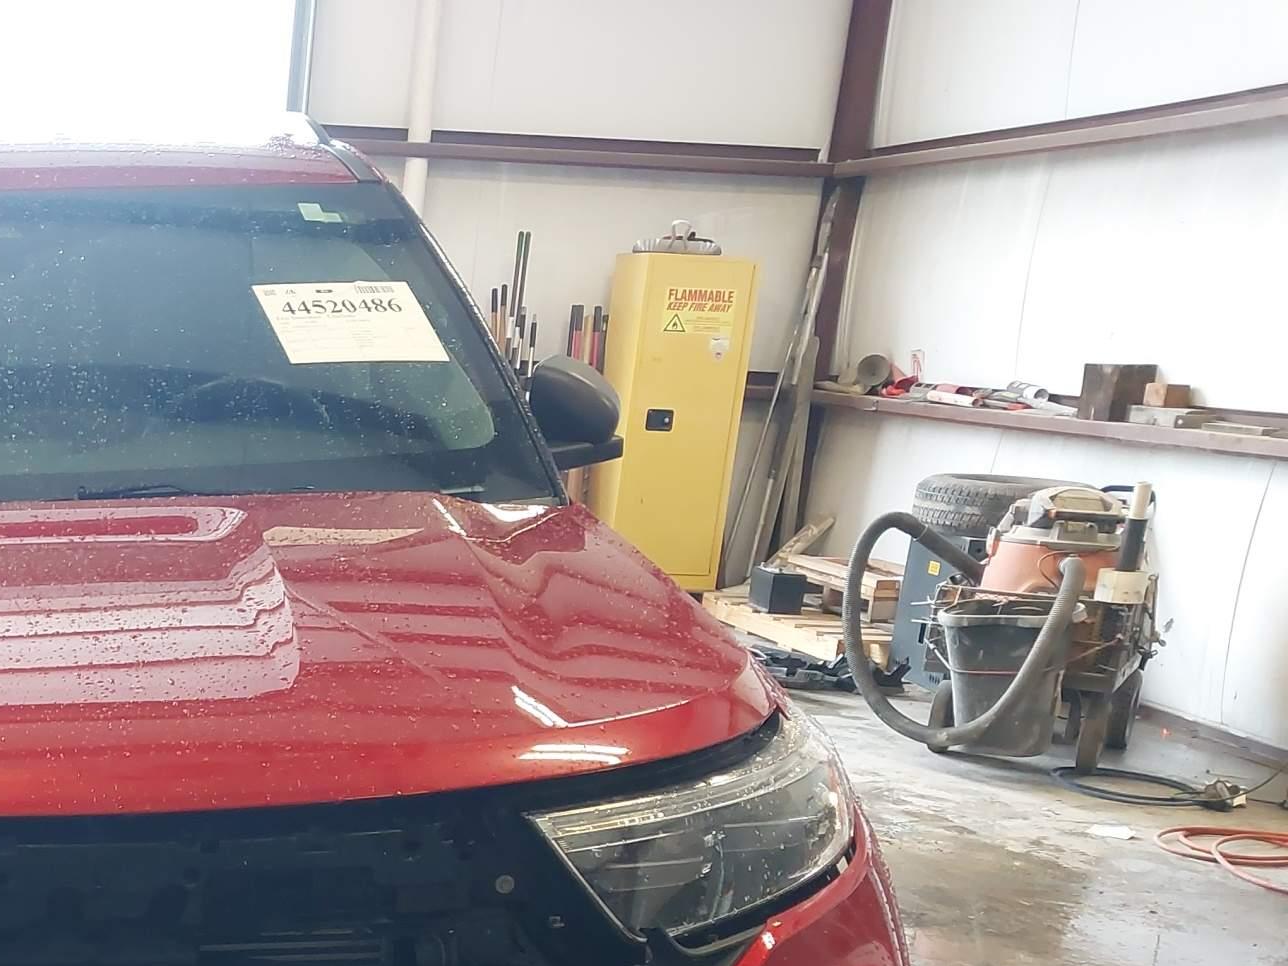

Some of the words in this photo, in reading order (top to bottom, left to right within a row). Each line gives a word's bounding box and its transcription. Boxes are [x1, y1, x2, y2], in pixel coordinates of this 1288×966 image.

[668, 288, 734, 303] FLAMMABLE
[282, 298, 402, 315] 44520486
[667, 302, 688, 311] KEEP
[688, 302, 708, 312] FIRE
[707, 303, 732, 313] AWAY
